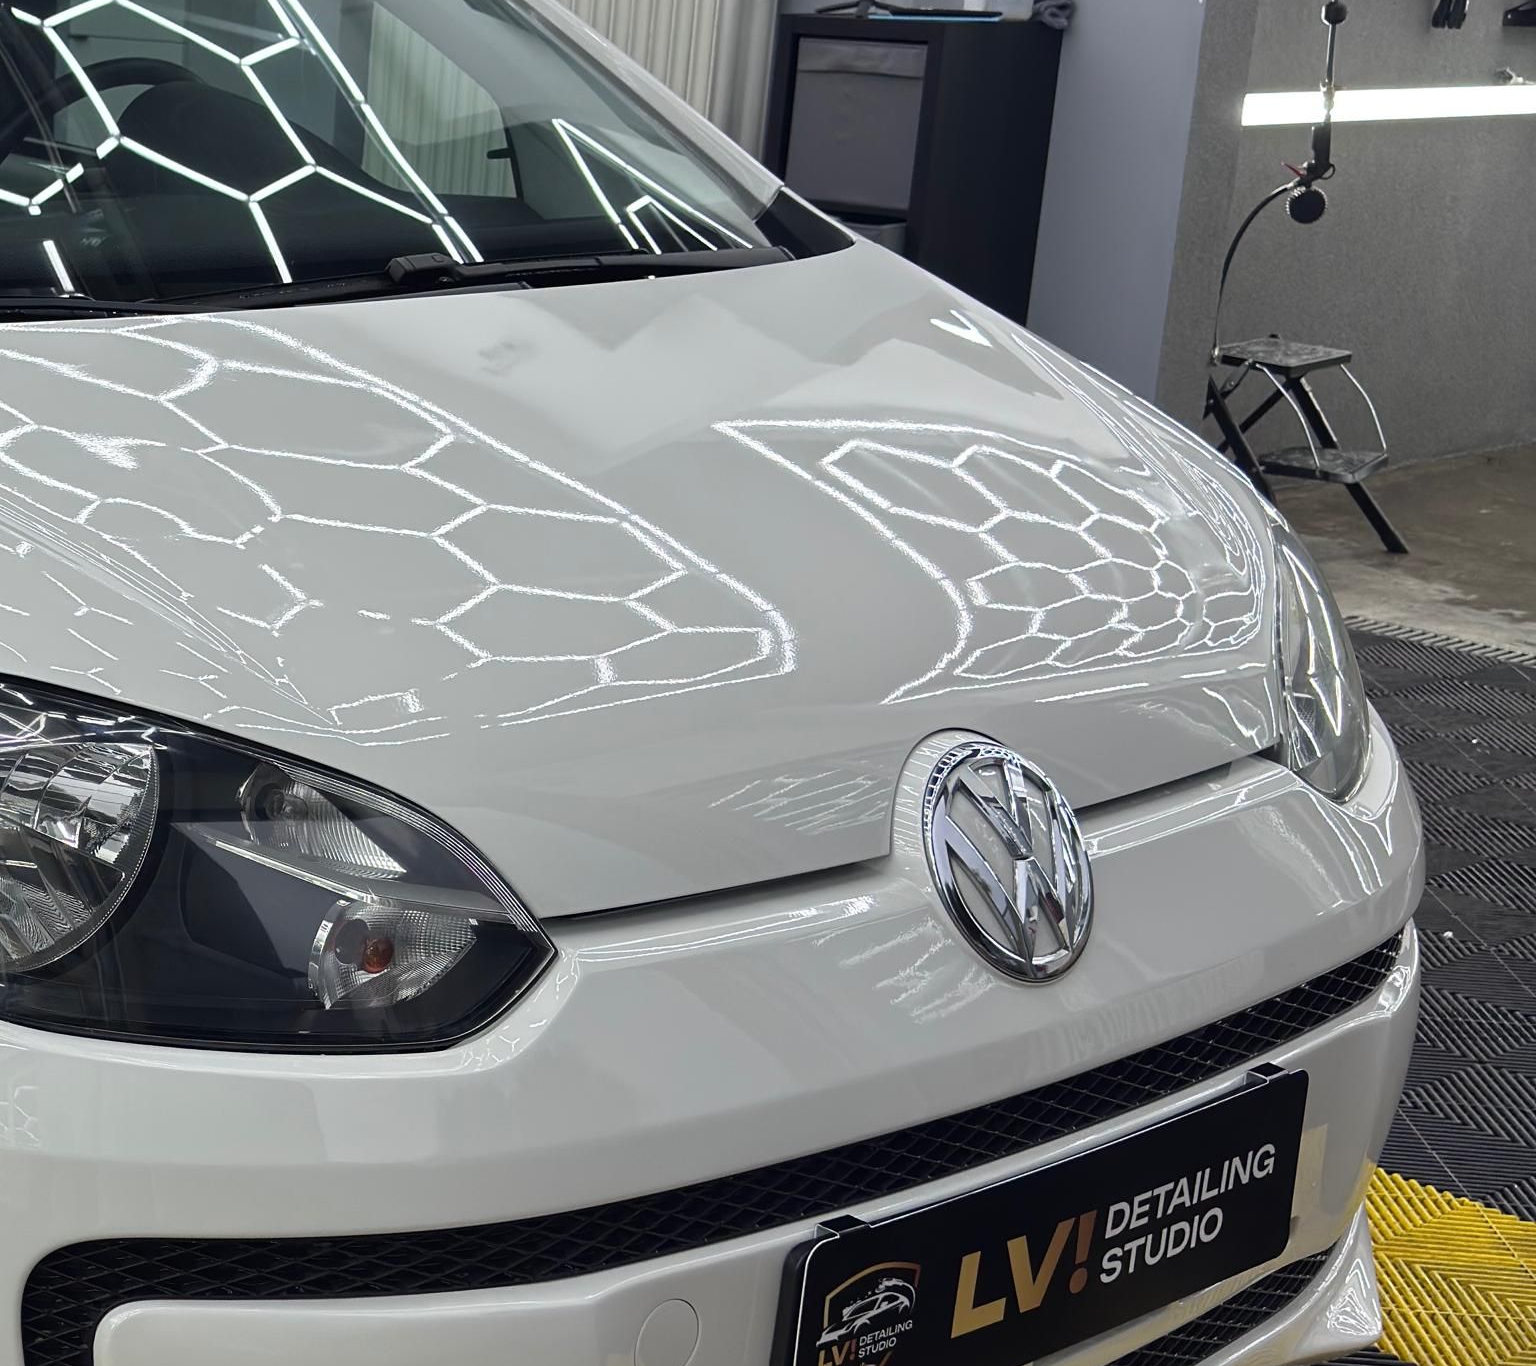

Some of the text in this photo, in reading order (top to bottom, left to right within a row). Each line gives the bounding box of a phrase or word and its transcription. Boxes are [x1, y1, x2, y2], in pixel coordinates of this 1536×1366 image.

[1105, 1143, 1276, 1239] DETAILING
[951, 1210, 1097, 1339] LV!
[1099, 1207, 1223, 1284] STUDIO
[858, 1337, 897, 1358] STUDIO
[859, 1319, 913, 1346] DETAILING
